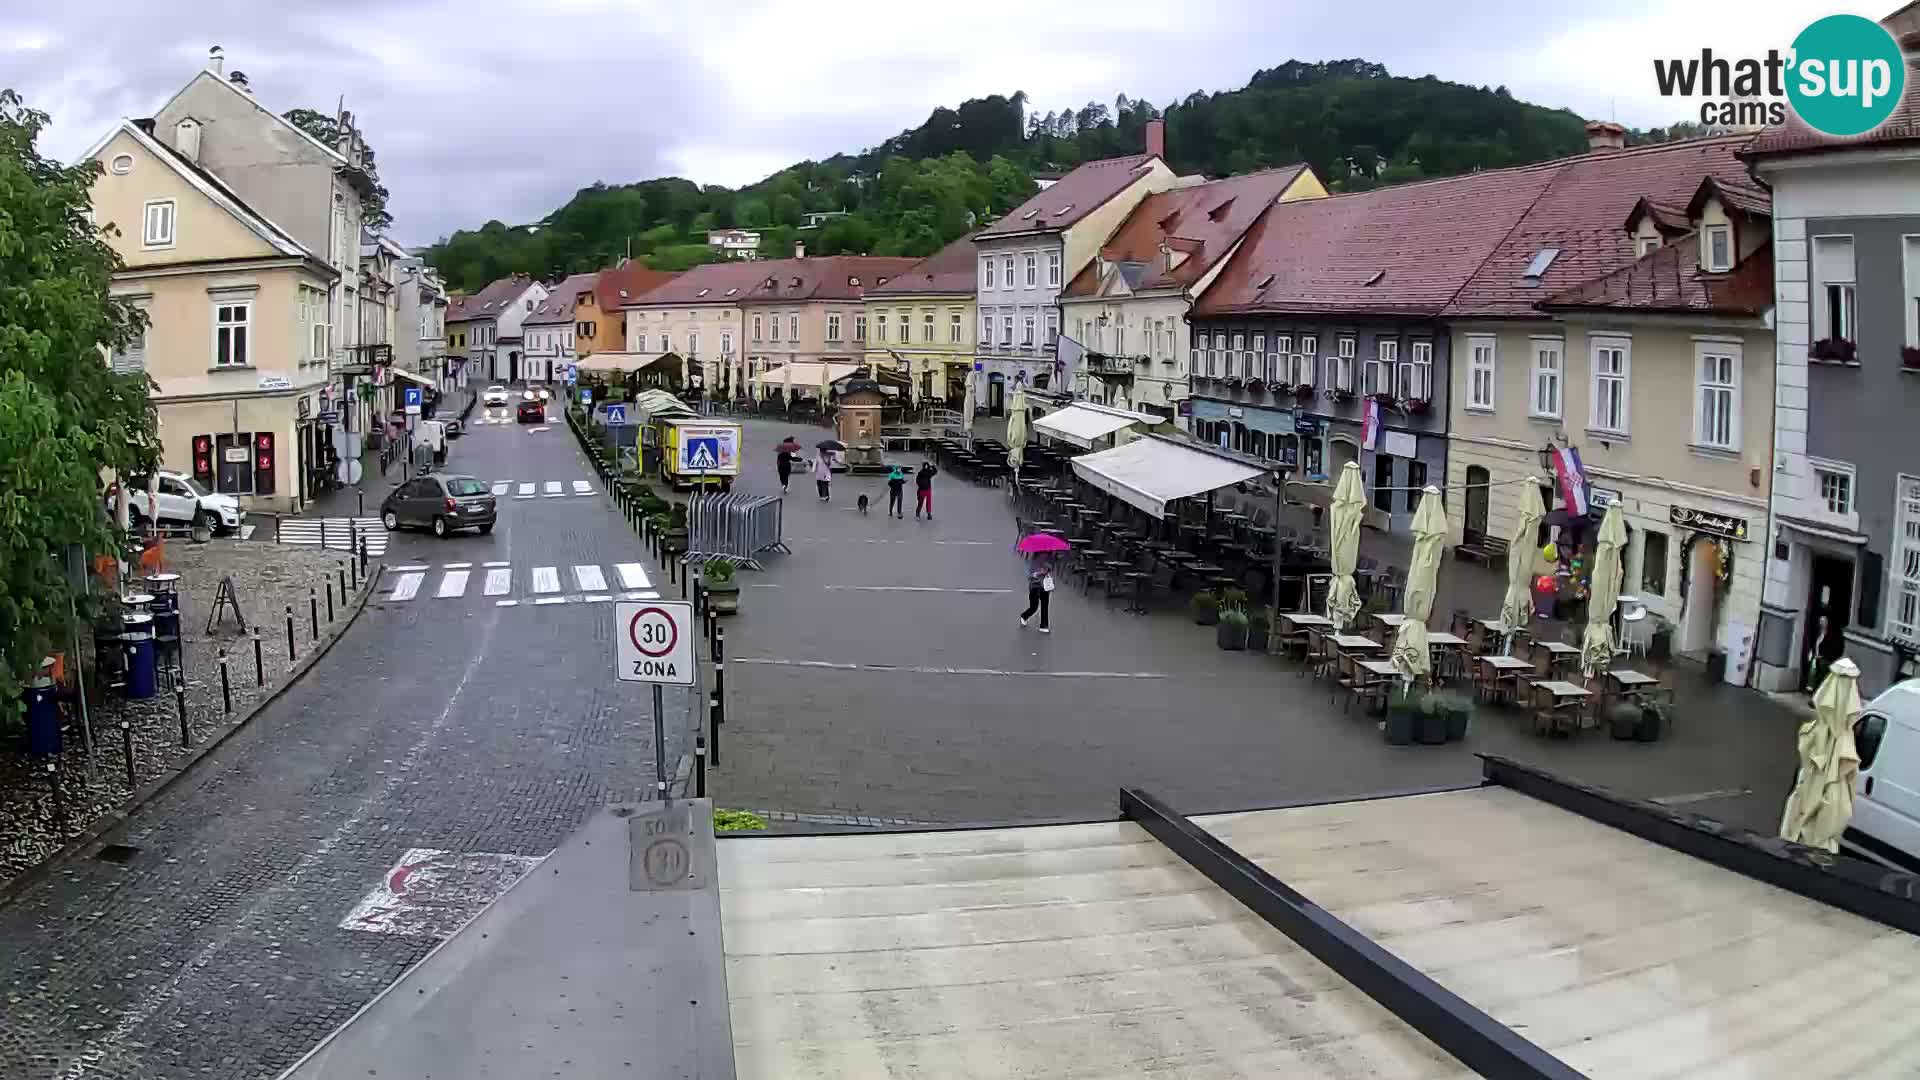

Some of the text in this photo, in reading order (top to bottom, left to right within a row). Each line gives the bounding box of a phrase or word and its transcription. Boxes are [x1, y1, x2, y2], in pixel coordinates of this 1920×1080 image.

[410, 392, 416, 402] P
[642, 623, 667, 644] 30
[632, 660, 677, 677] ZONA
